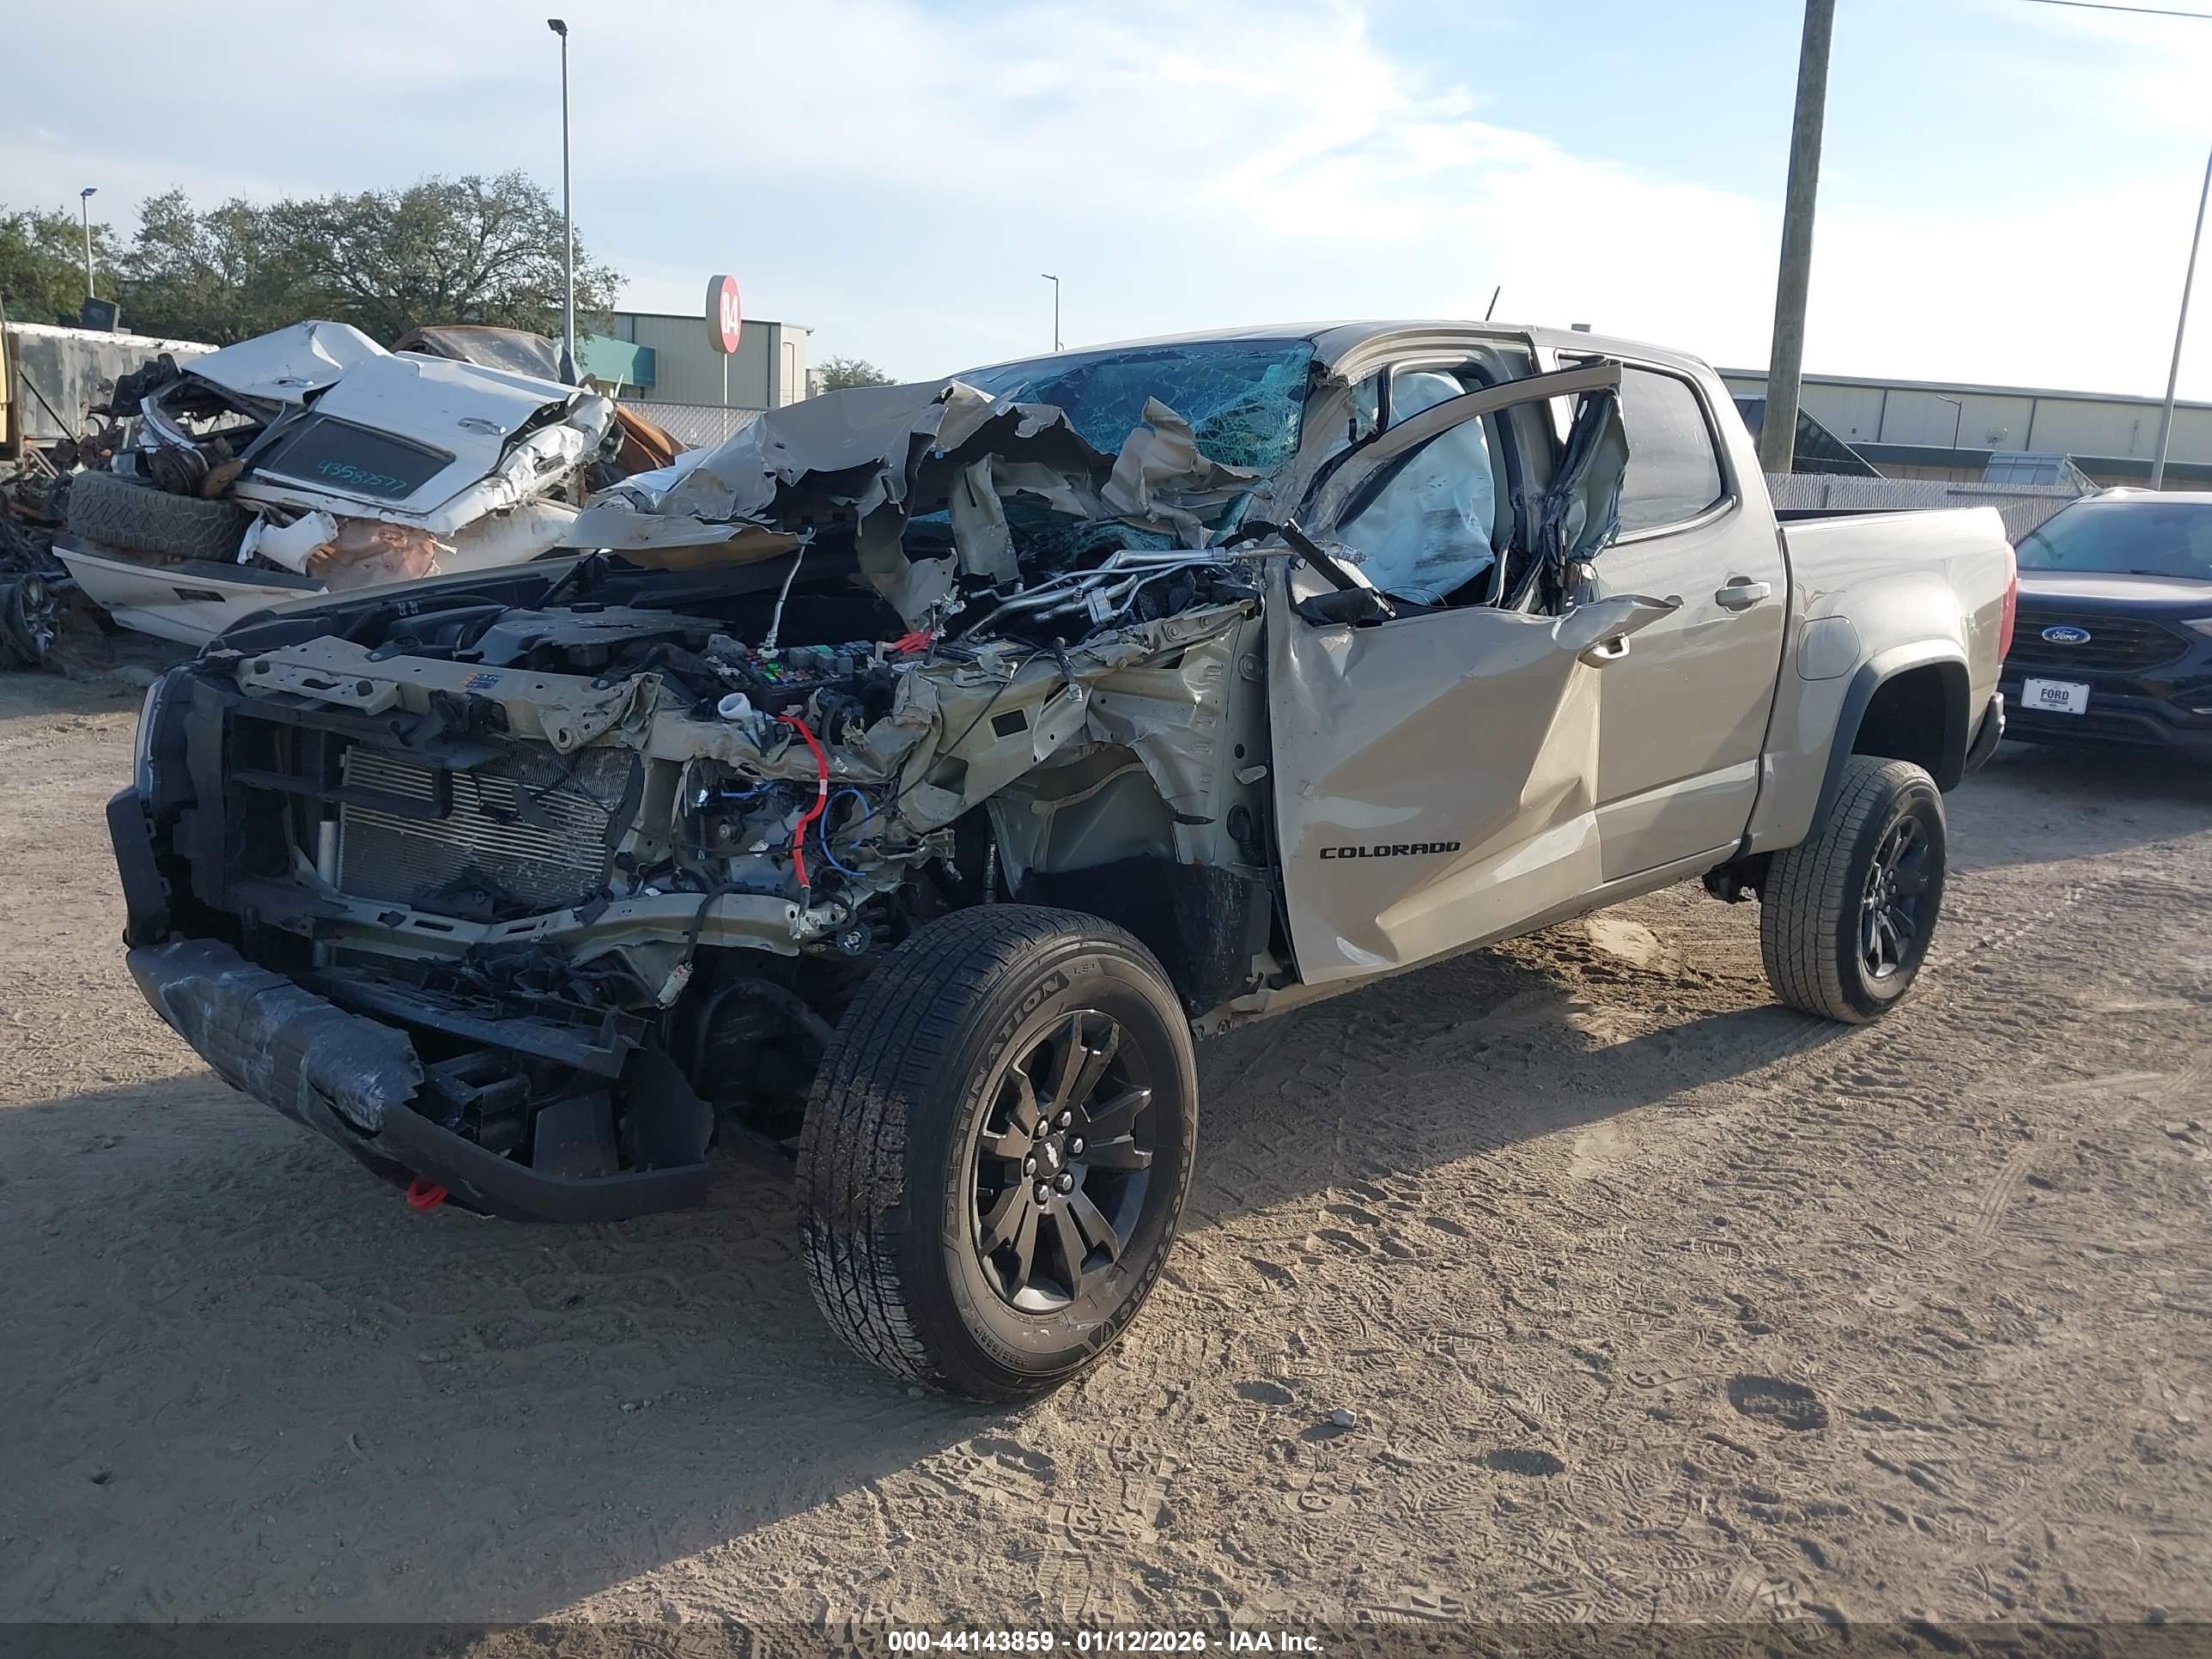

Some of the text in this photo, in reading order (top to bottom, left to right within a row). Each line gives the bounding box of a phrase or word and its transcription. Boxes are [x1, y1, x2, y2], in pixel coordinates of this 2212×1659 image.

[2040, 688, 2069, 701] FORD
[1320, 842, 1462, 860] COLORADO
[945, 975, 1060, 1227] DESTINATION
